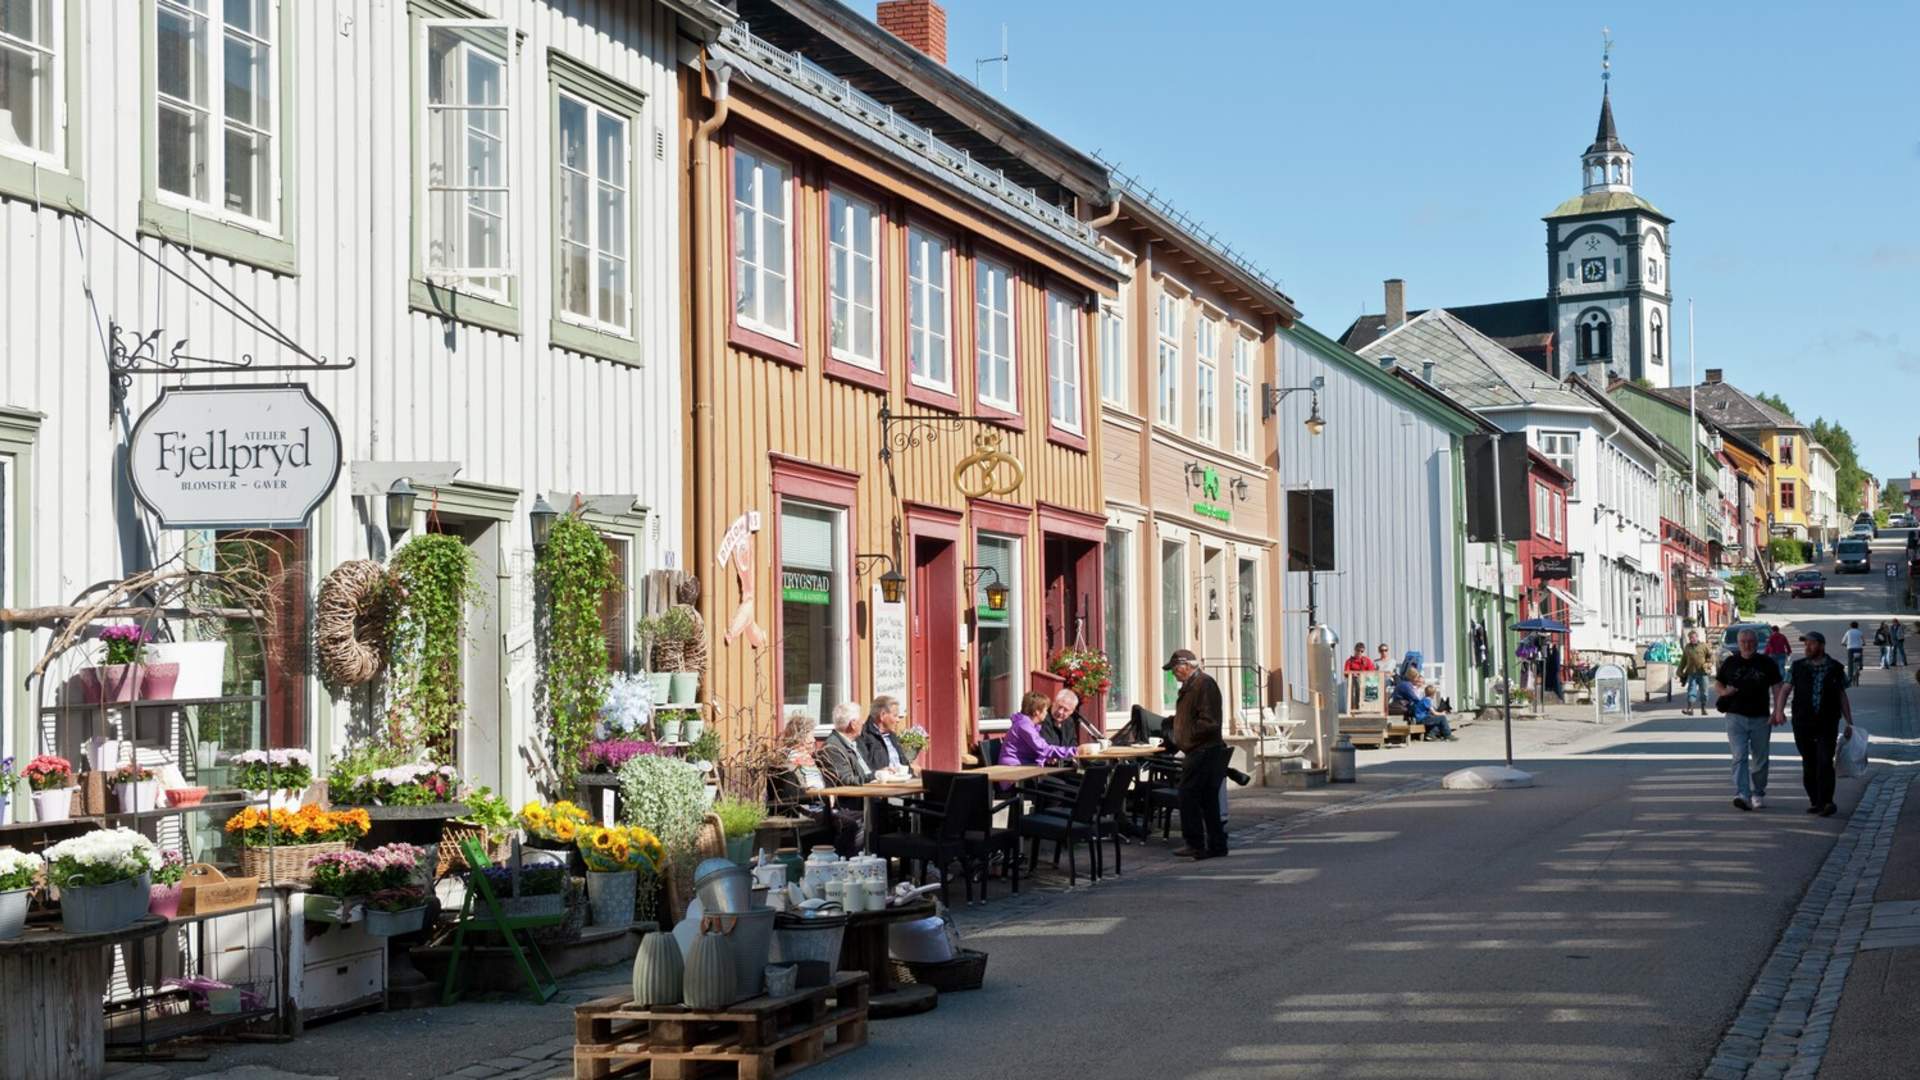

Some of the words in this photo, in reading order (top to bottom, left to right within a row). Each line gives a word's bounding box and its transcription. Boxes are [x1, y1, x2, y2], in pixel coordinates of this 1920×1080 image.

[244, 431, 287, 441] ATELIER
[154, 426, 312, 478] Fjellpryd
[181, 480, 237, 491] BLOMSTER
[253, 479, 288, 490] GAVER
[782, 572, 830, 593] TRYGSTAD
